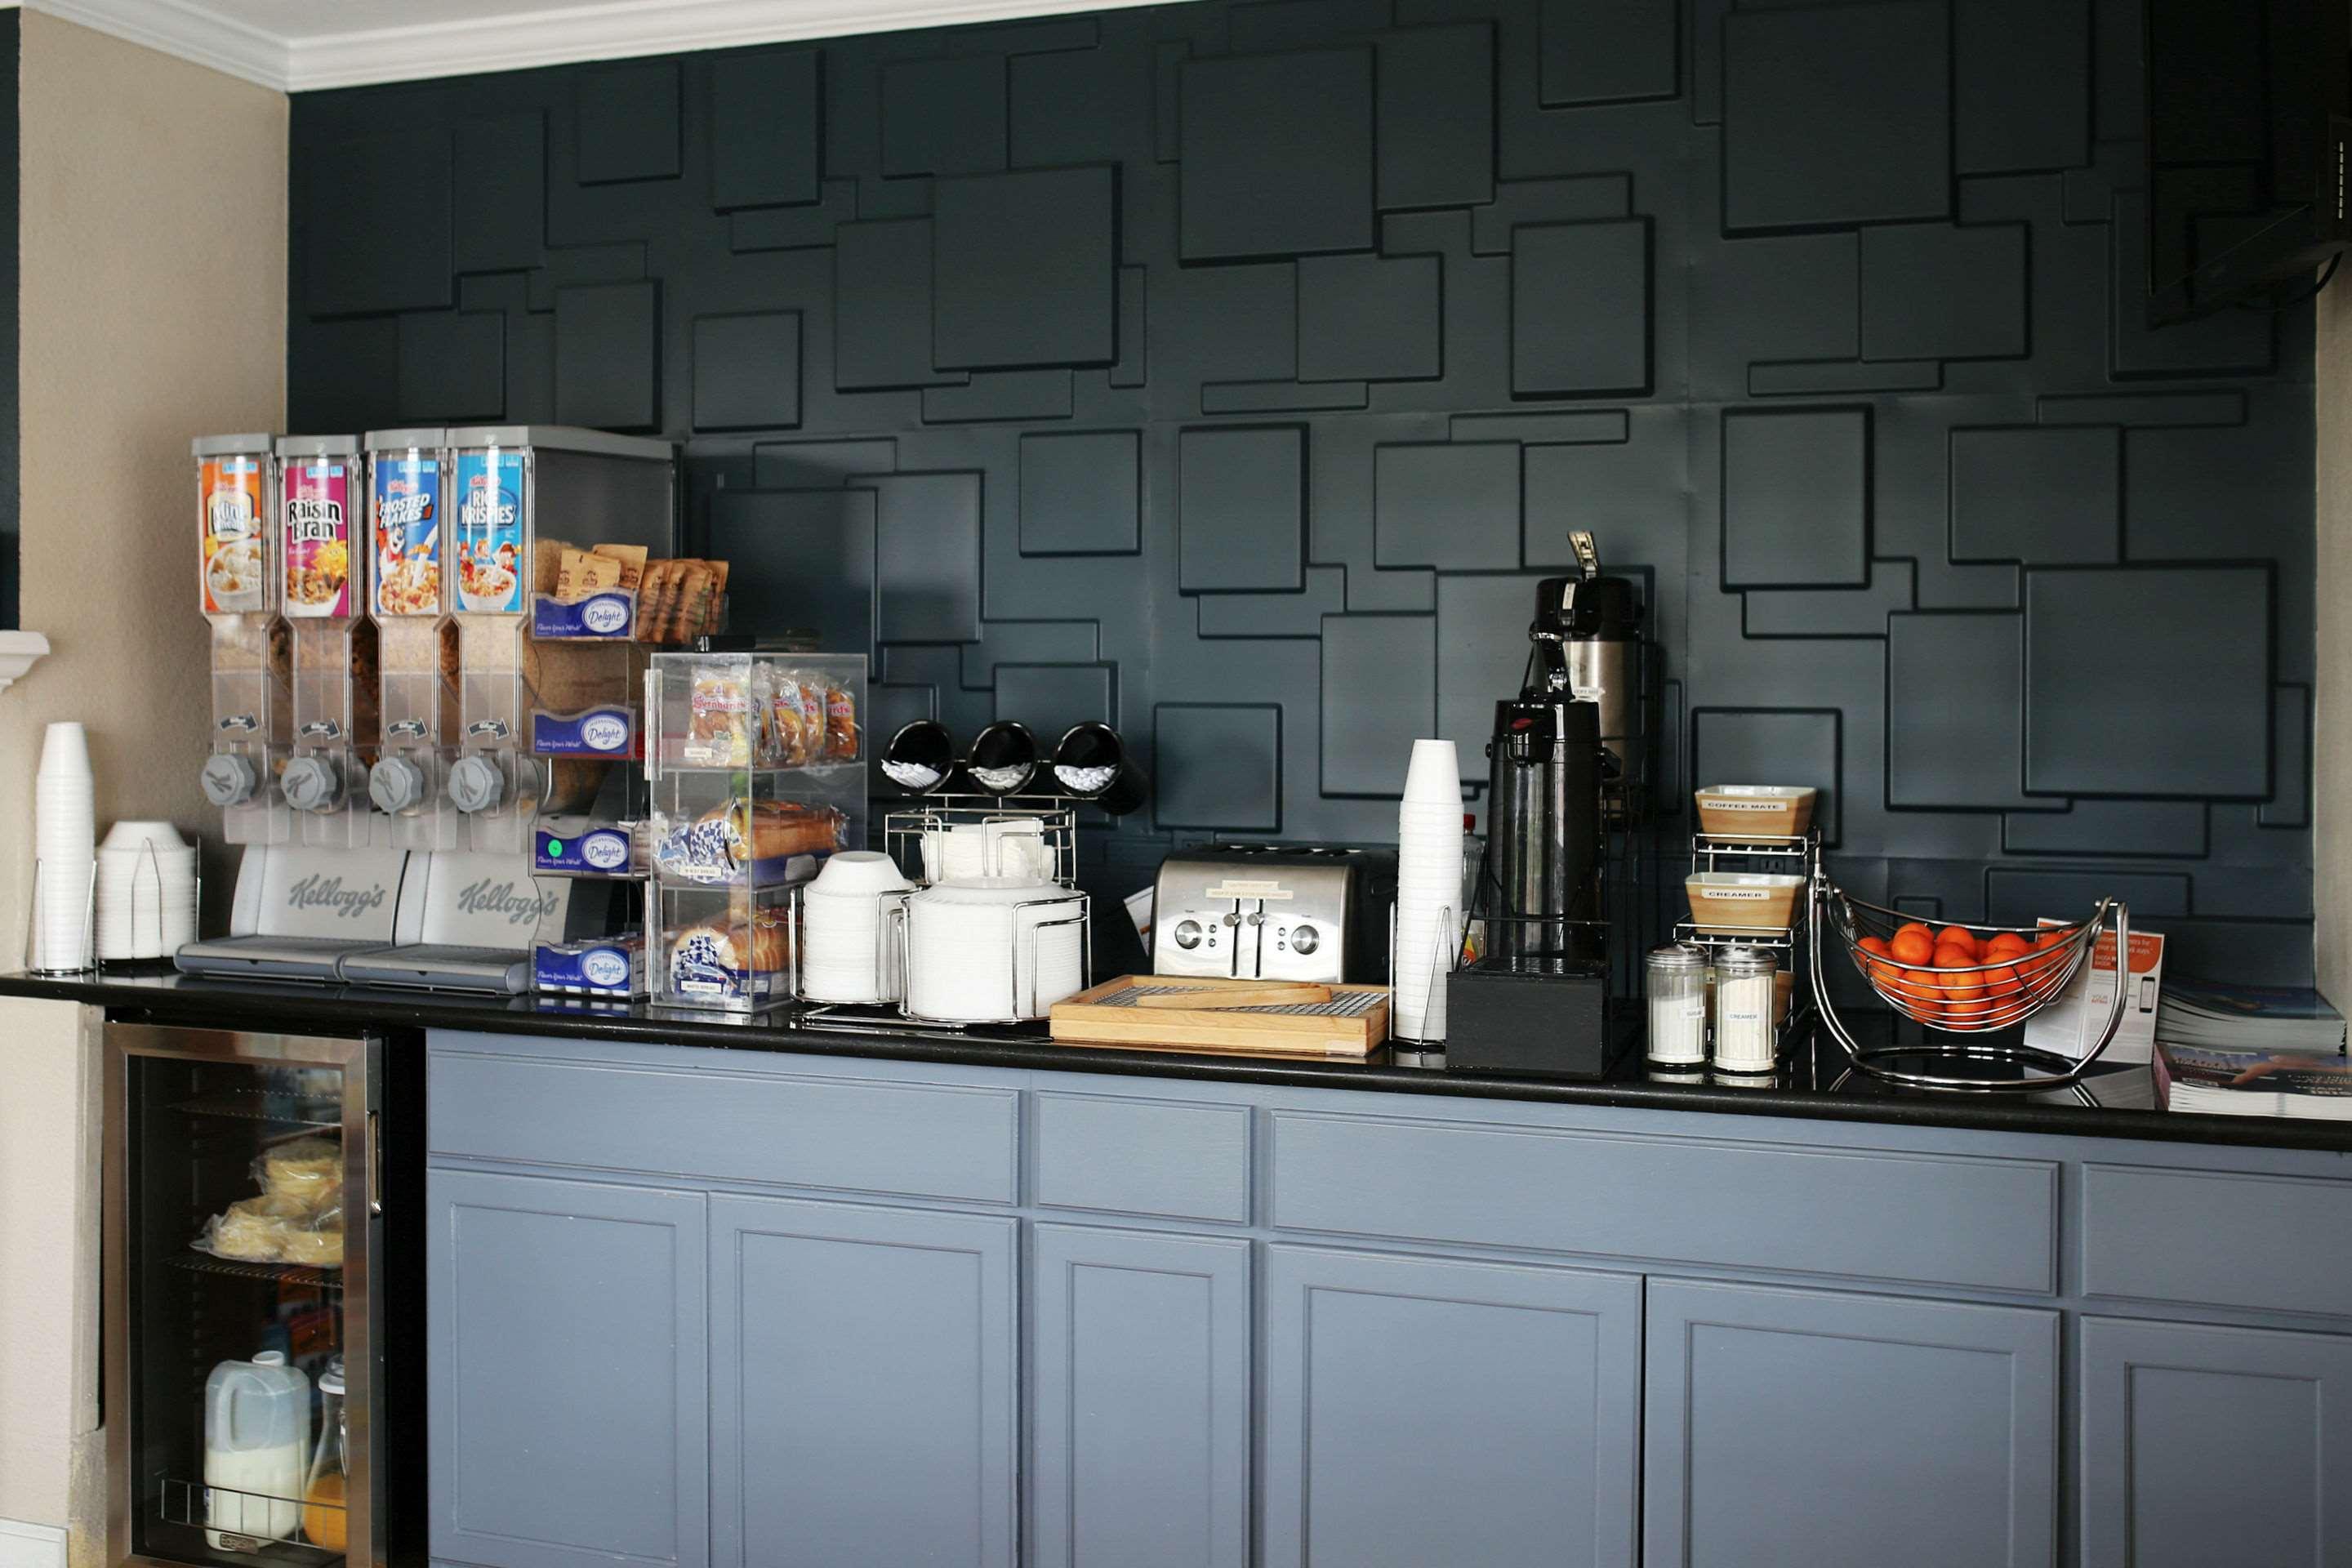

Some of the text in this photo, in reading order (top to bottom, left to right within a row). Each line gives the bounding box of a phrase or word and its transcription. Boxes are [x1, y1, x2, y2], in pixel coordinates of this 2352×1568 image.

[288, 500, 342, 523] Raisin
[379, 492, 430, 518] FROSTED
[380, 508, 423, 529] FLAKES
[461, 506, 514, 525] KRISPIES
[294, 521, 335, 541] Bran
[588, 609, 621, 628] Delight
[588, 726, 621, 745] Delight
[588, 844, 621, 863] Delight
[288, 873, 386, 918] Kellogg's
[457, 878, 560, 925] Kellogg's
[588, 962, 621, 981] Delight
